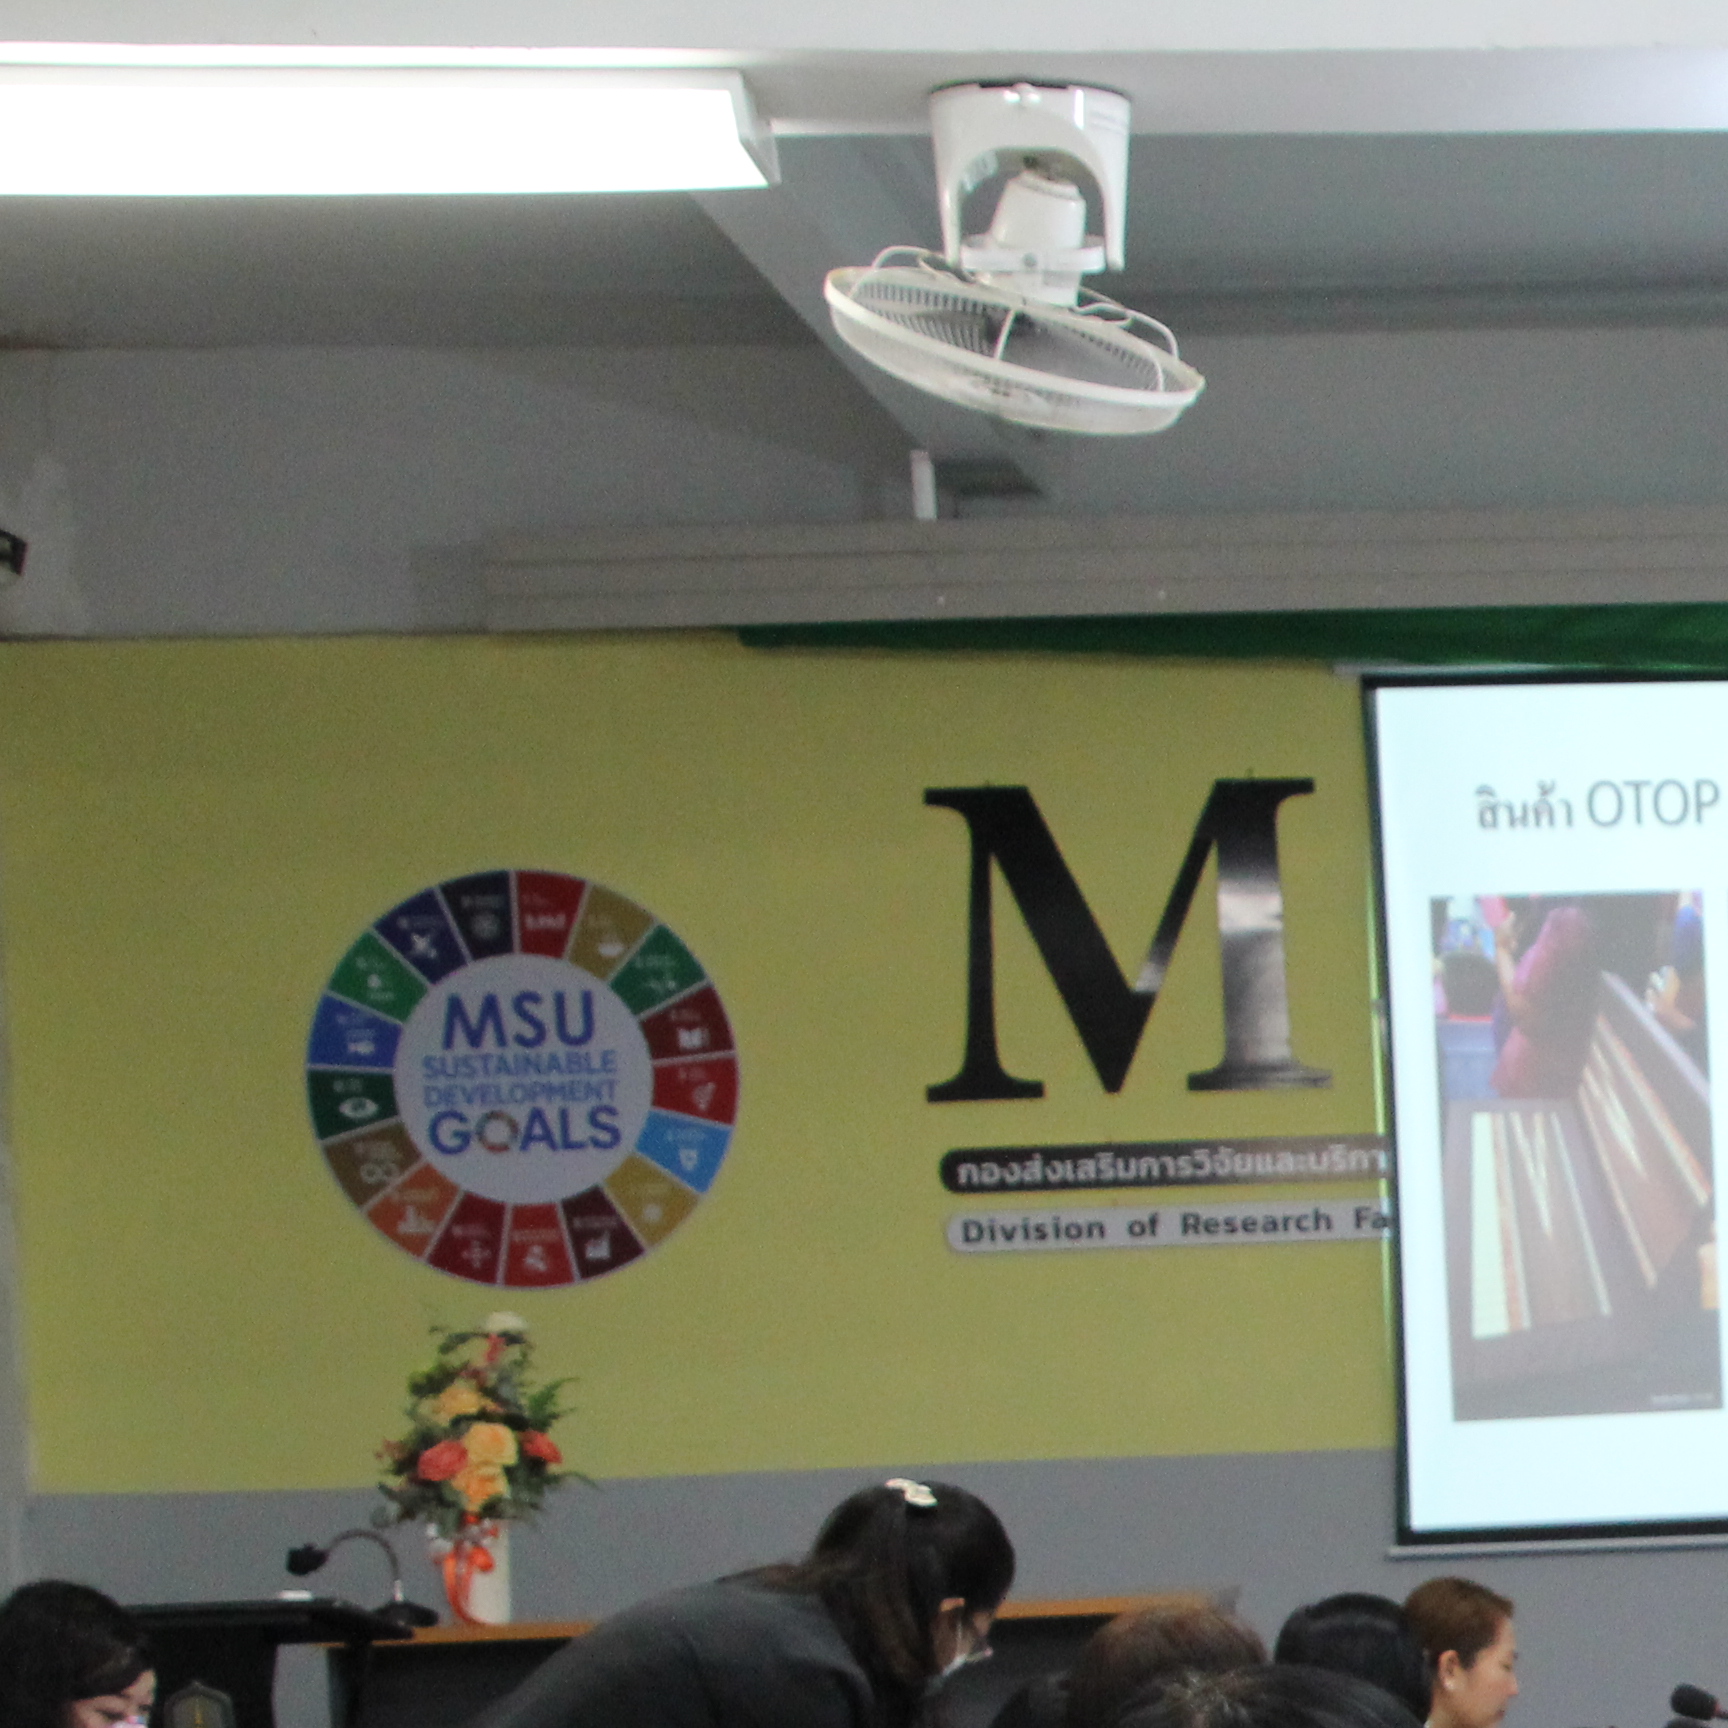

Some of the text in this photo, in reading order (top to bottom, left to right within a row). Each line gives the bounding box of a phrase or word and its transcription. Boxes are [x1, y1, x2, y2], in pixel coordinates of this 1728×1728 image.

[1587, 778, 1721, 828] OTOP
[441, 989, 596, 1049] MSU
[422, 1049, 617, 1077] SUSTAINABLE
[423, 1079, 616, 1107] DEVELOPMENT
[429, 1105, 622, 1155] GOALS
[962, 1215, 1105, 1245] Division
[1127, 1212, 1160, 1239] of
[1181, 1207, 1333, 1237] Research
